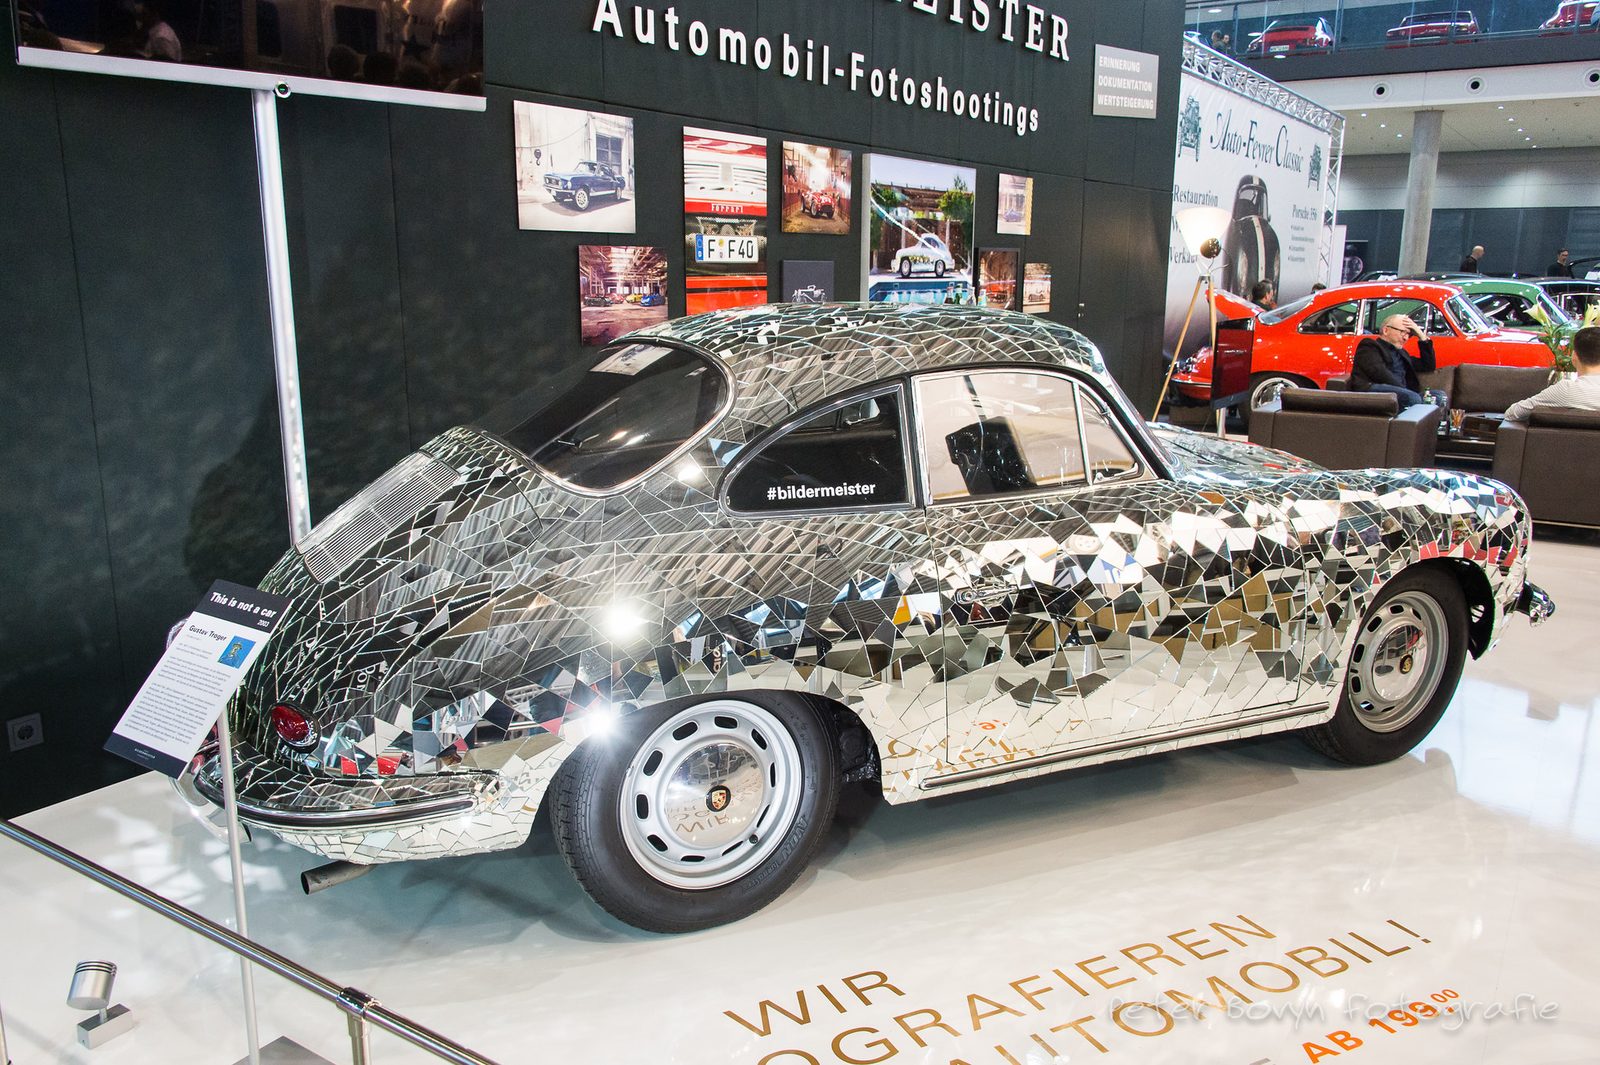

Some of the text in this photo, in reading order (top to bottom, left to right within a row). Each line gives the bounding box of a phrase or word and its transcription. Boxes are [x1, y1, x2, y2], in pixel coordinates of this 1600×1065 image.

[592, 0, 1039, 136] Automobil-Fotoshootings
[1099, 56, 1140, 72] ERINNERUNG
[1098, 75, 1153, 91] DOKUMENTATION
[1097, 94, 1154, 110] WERTSTEIGERUNG
[1275, 125, 1304, 173] Classic
[1174, 185, 1219, 207] Restauration
[708, 239, 754, 259] F F40
[767, 482, 876, 500] #bildermeister
[210, 591, 277, 618] This is not a car
[189, 624, 208, 636] Gustav
[949, 918, 1432, 1065] UTOMOBIL!
[722, 970, 907, 1037] WIR
[1302, 1030, 1364, 1064] AB
